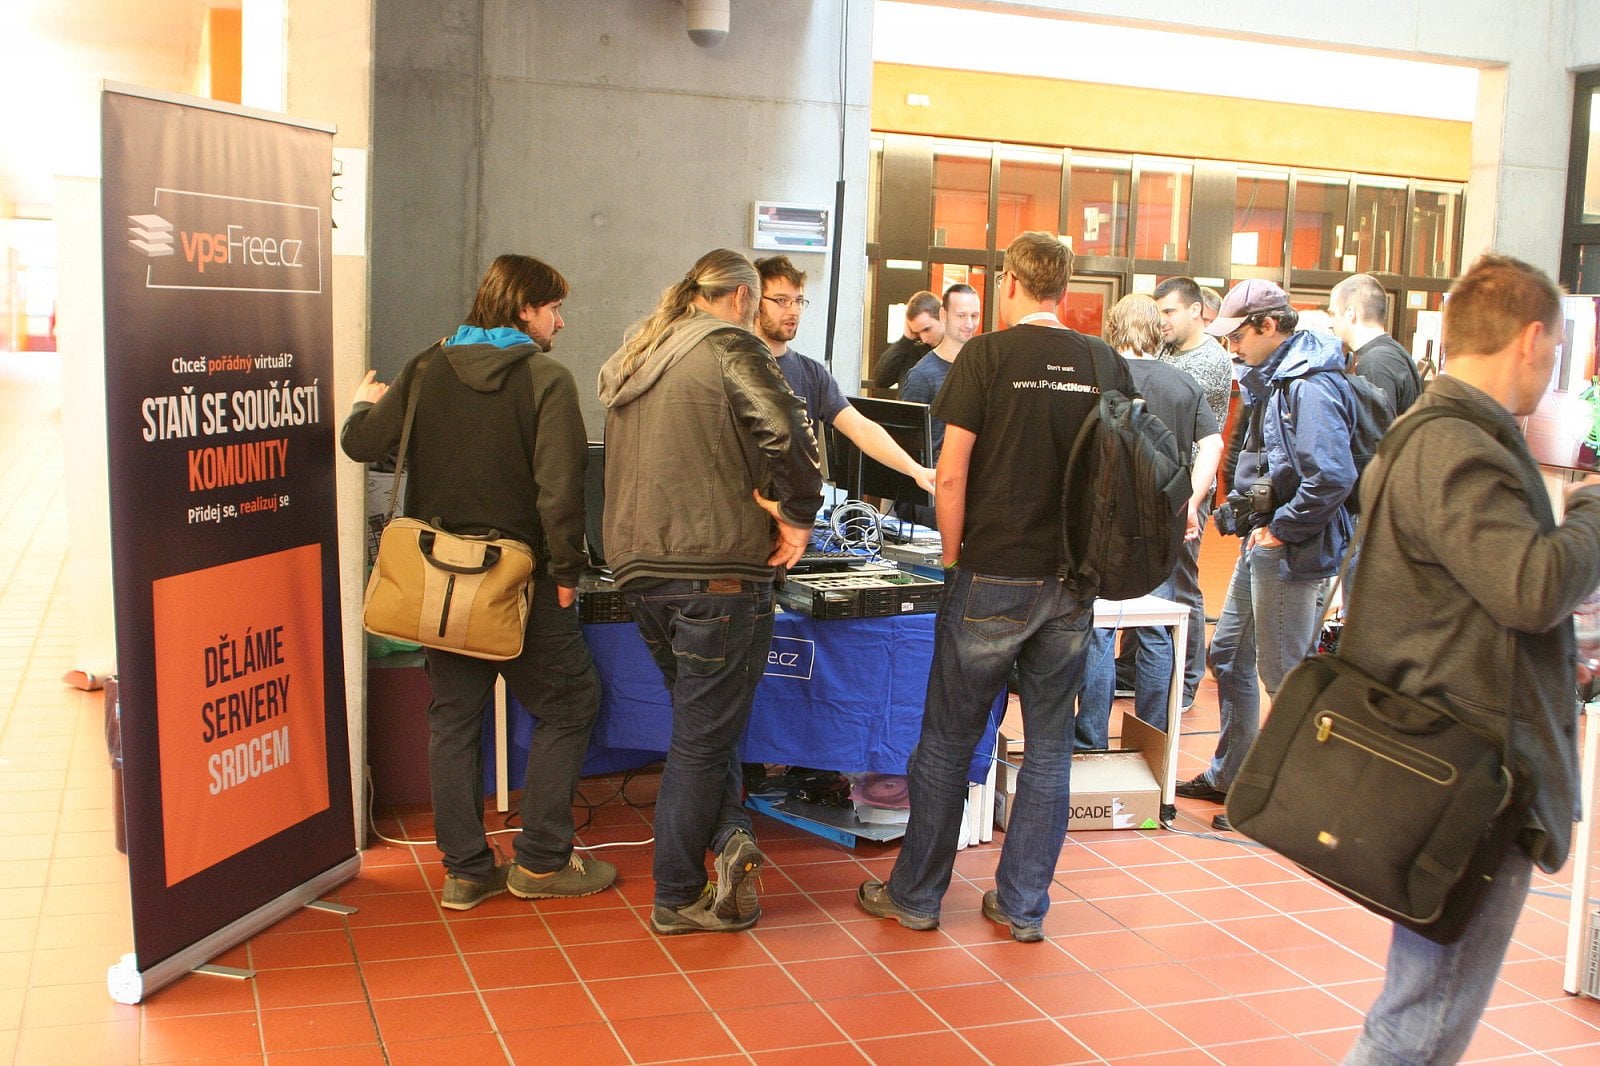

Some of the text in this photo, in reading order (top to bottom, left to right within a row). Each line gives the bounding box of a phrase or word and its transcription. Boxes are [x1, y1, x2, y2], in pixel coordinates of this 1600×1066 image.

[180, 224, 303, 273] vpsFree.cz
[171, 353, 293, 376] Chceš pořádný virtuál?
[1046, 364, 1061, 372] Don't
[141, 378, 320, 442] STAŇ SE SOUČÁSTÍ
[187, 438, 289, 492] KOMUNITY
[188, 494, 290, 524] Přidej se, realizuj se
[204, 625, 284, 689] DĚLÁME
[201, 674, 290, 744] SERVERY
[208, 725, 290, 796] SRDCEM
